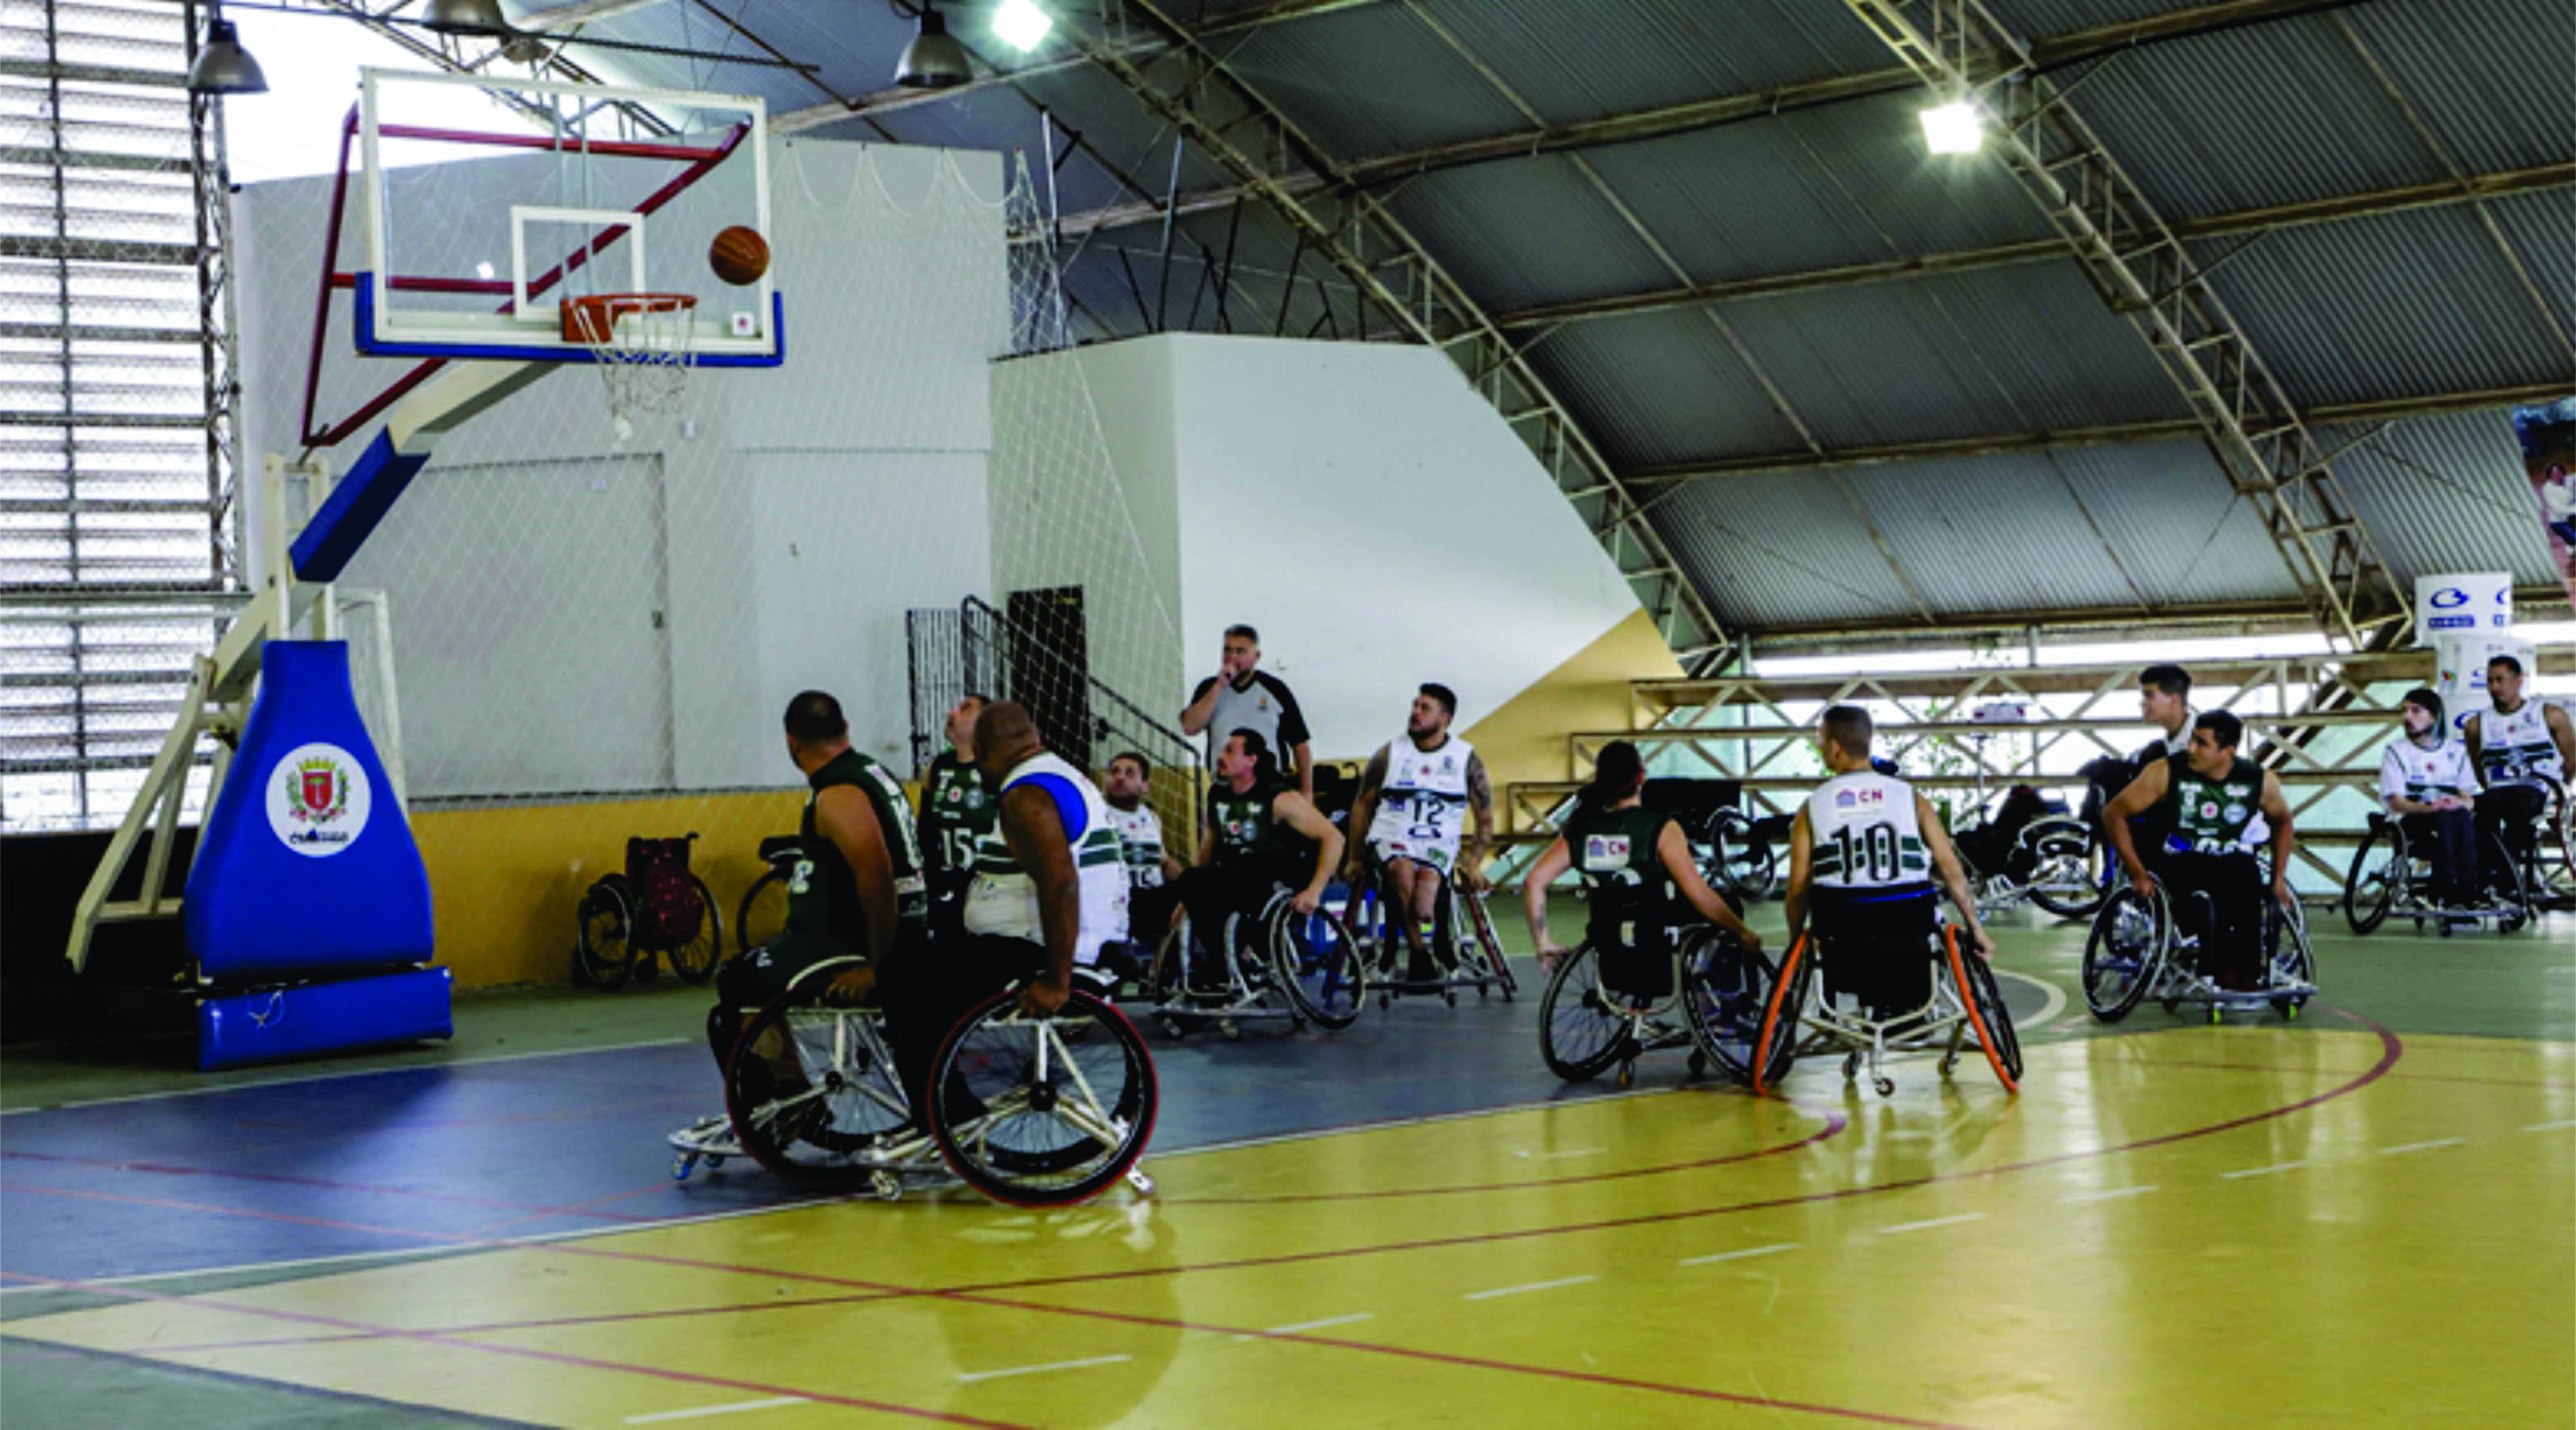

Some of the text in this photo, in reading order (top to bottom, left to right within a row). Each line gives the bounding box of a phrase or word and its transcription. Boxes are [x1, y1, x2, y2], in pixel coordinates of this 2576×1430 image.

[1414, 798, 1445, 825] 12
[1858, 789, 1883, 803] CN
[940, 828, 975, 871] 15
[1830, 822, 1899, 885] 10
